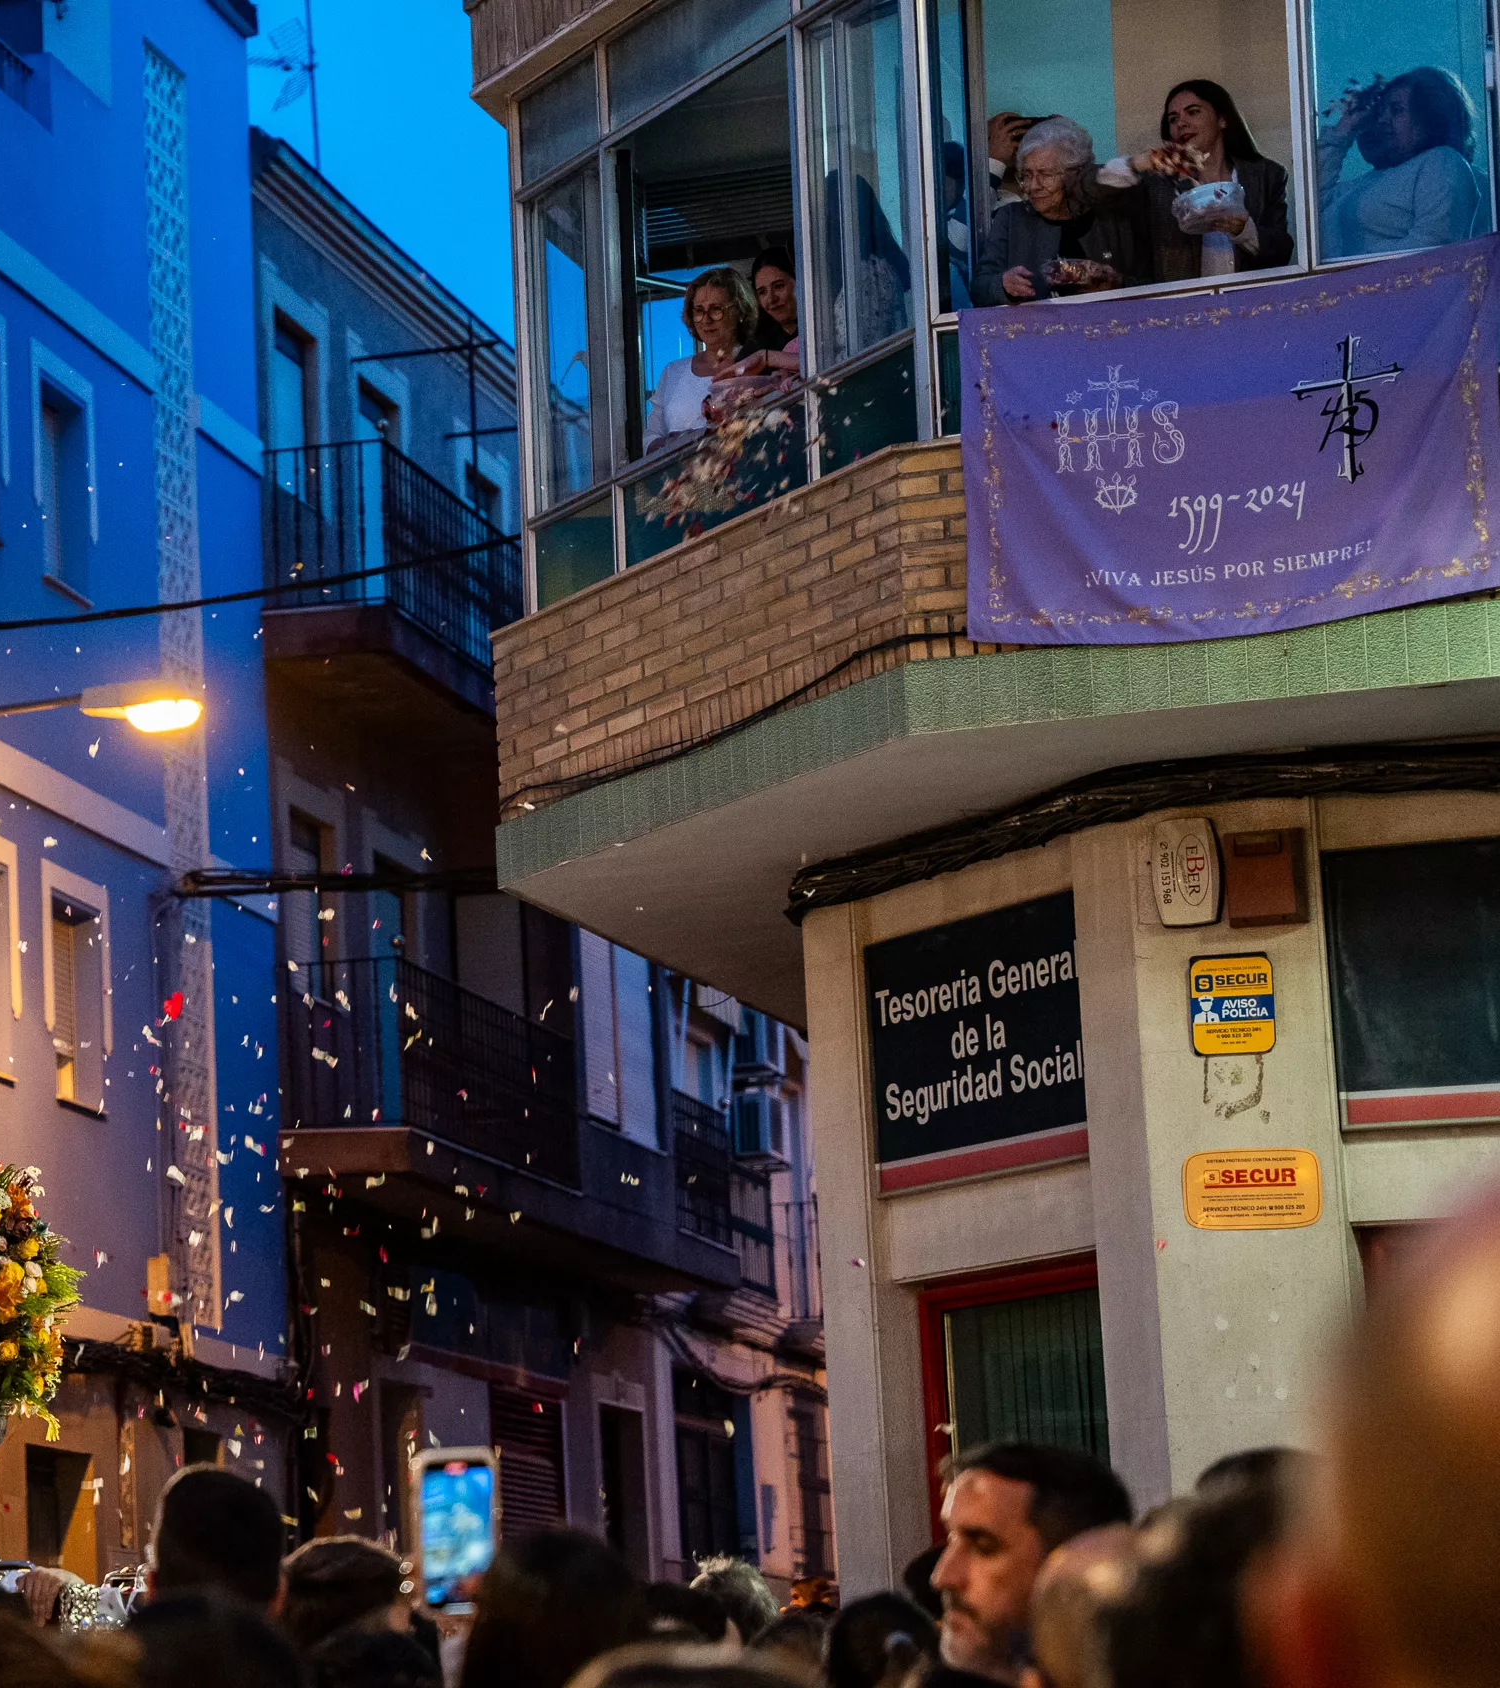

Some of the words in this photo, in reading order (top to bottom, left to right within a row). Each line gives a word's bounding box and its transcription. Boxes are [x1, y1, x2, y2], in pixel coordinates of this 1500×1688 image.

[1168, 480, 1306, 555] 1599-2024
[1085, 568, 1142, 588] ¡VIVA
[1151, 564, 1216, 586] JESÚS
[1224, 560, 1265, 579] POR
[1273, 540, 1372, 573] SIEMPRE!
[1160, 852, 1169, 868] 902
[1161, 871, 1171, 886] 153
[1163, 888, 1172, 905] 968
[1215, 973, 1268, 985] SECUR
[875, 969, 981, 1027] Tesoreria
[1222, 998, 1257, 1009] AVISO
[1222, 1007, 1269, 1018] POLICIA
[951, 1020, 979, 1059] de
[985, 1013, 1006, 1051] la
[886, 1059, 1002, 1125] Seguridad
[1010, 1040, 1084, 1093] Social
[1221, 1168, 1296, 1184] SECUR
